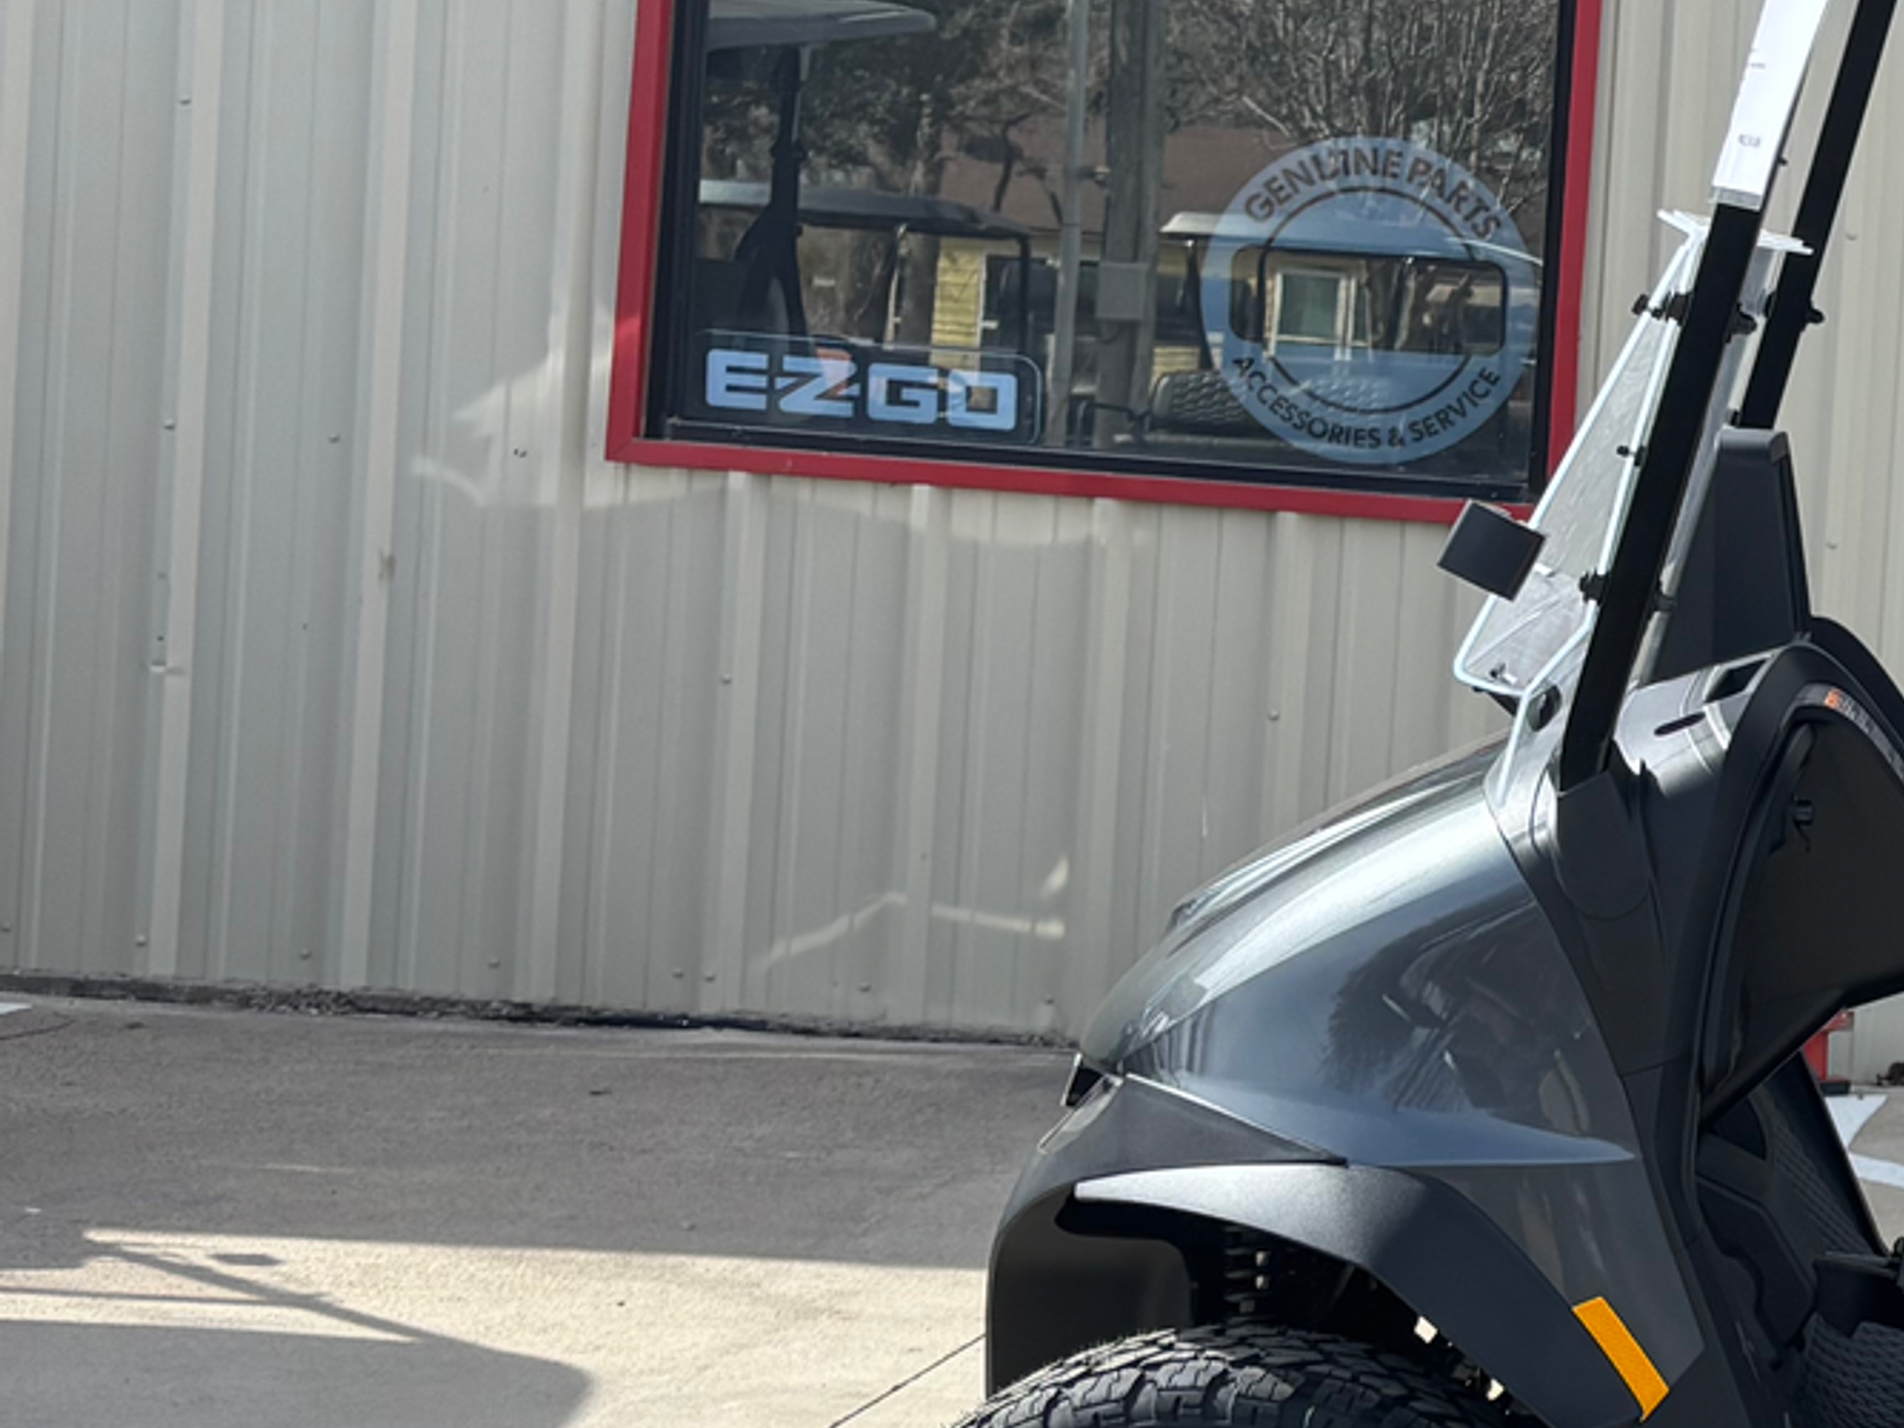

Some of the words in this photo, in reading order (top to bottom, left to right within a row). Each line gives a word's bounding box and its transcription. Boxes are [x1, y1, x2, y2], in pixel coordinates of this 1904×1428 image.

[1244, 146, 1404, 222] GENUINE
[1406, 158, 1502, 241] PARTS
[1231, 356, 1381, 449] ACCESSORIES
[1388, 427, 1406, 448] &
[1410, 368, 1501, 443] SERVICE
